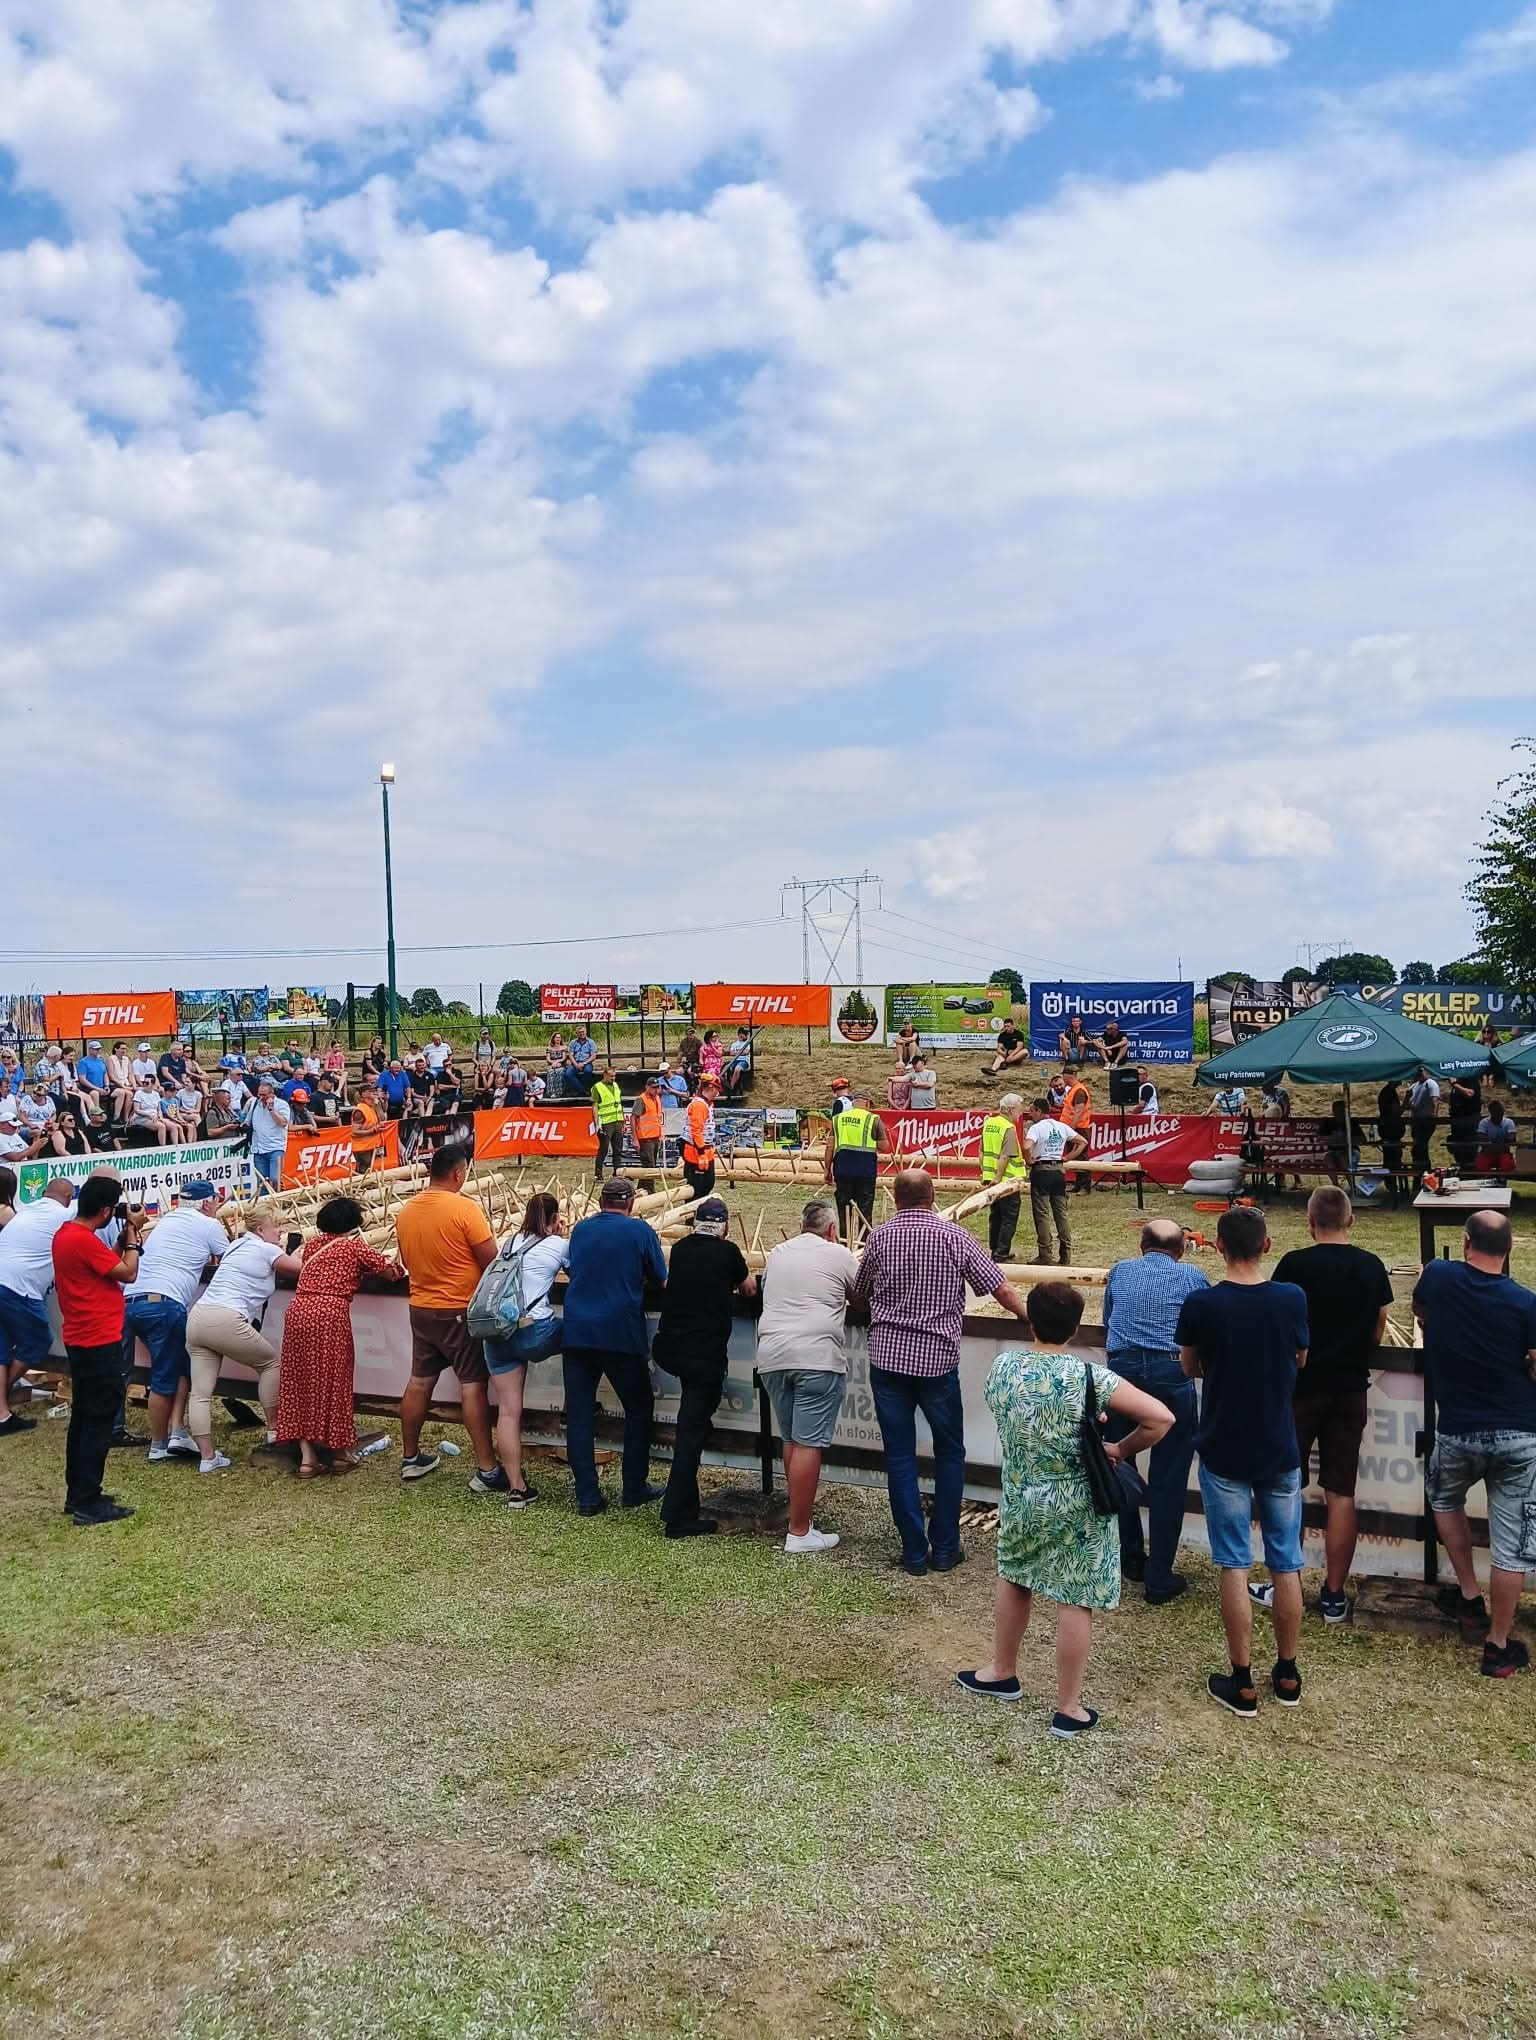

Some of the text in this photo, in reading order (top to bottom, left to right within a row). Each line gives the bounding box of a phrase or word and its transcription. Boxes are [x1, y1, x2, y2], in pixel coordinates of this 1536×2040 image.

[544, 988, 582, 998] PELLET
[559, 997, 613, 1007] DRZEWNY
[730, 996, 794, 1013] STIHL
[1065, 995, 1178, 1017] Husqvarna
[1402, 993, 1480, 1011] SKLEP
[82, 1005, 144, 1026] STIHL
[564, 1012, 577, 1020] 781
[1233, 1008, 1299, 1022] mebl
[1139, 1040, 1162, 1048] Lepsy
[1033, 1049, 1062, 1057] Praszka
[1142, 1050, 1155, 1058] 787
[1158, 1050, 1172, 1058] 071
[1174, 1050, 1189, 1058] 021
[1440, 1062, 1455, 1070] Lasy
[1214, 1072, 1228, 1080] Lasy
[500, 1121, 565, 1142] STIHL
[50, 1163, 76, 1178] XXIV
[180, 1146, 219, 1163] ZAWODY
[297, 1142, 356, 1171] STIH
[206, 1165, 232, 1181] 2025
